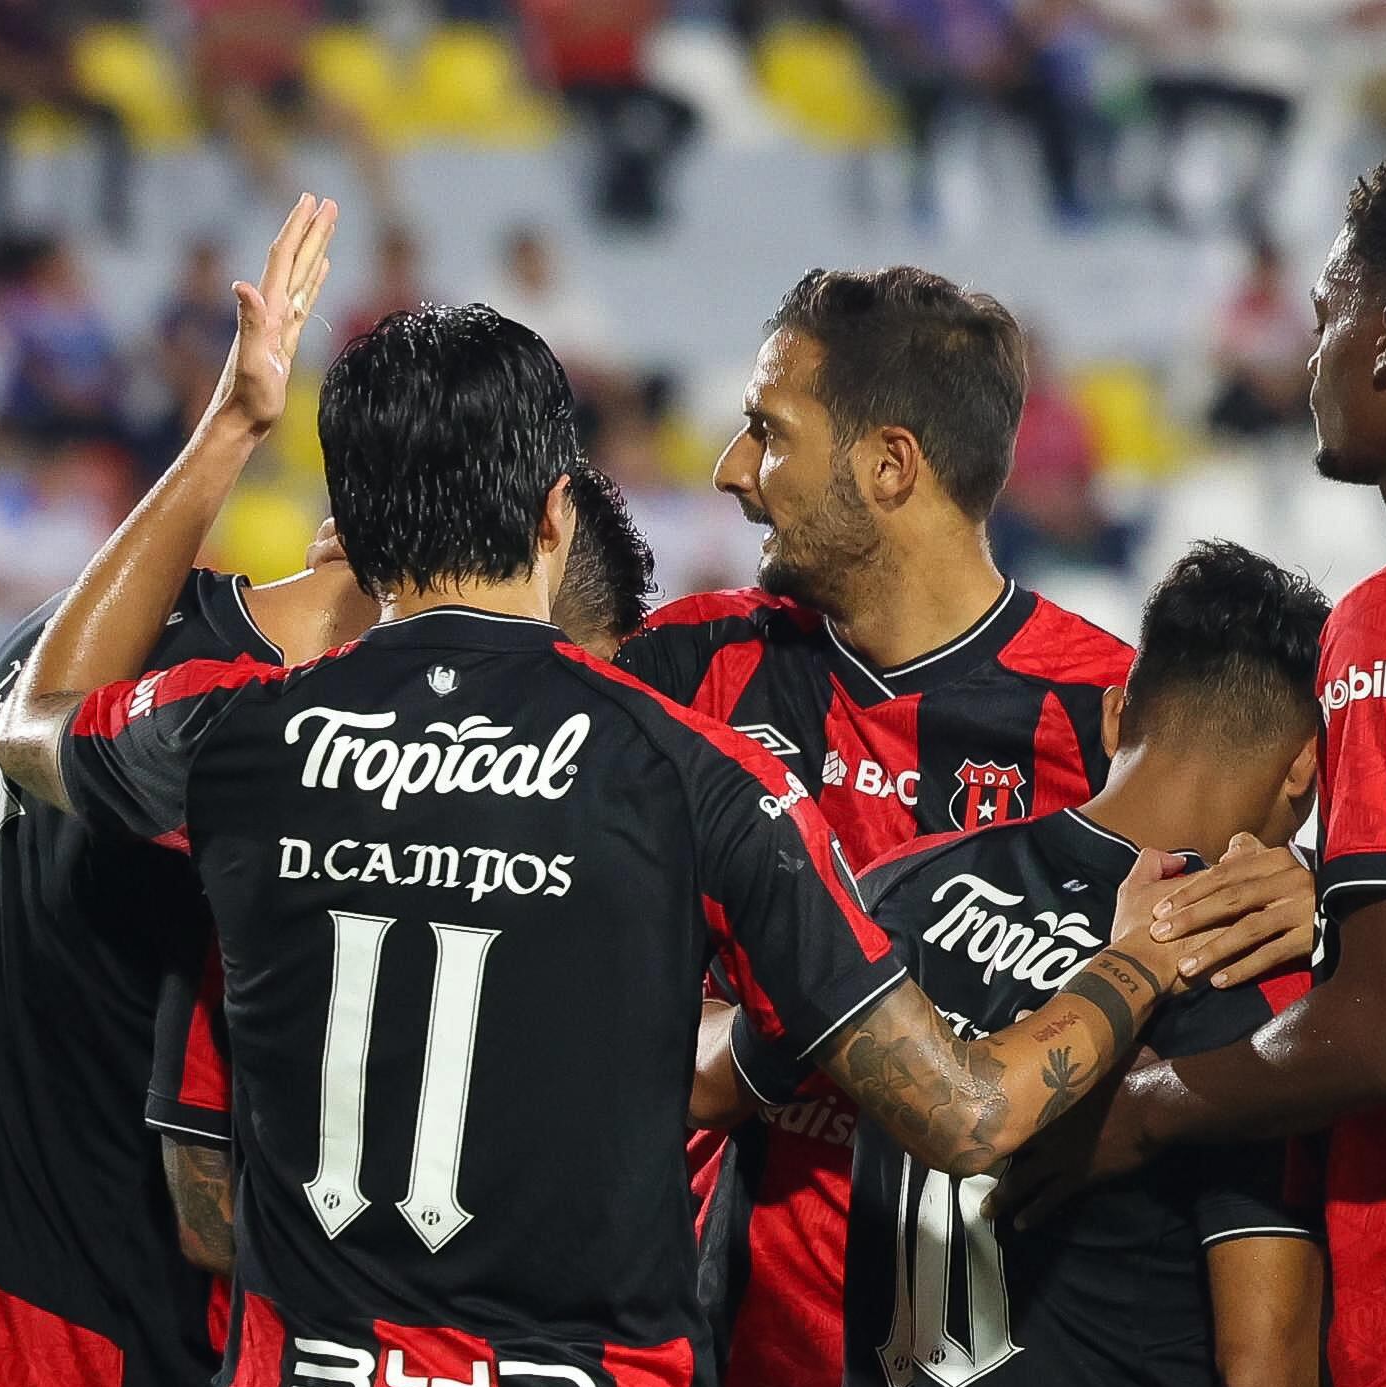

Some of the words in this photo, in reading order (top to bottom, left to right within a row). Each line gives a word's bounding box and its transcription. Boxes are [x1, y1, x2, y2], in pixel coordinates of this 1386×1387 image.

[284, 706, 591, 811] Tropical
[968, 770, 1011, 787] LDA
[278, 836, 576, 903] D.CAMPOS
[922, 873, 1094, 991] Tropic
[302, 910, 503, 1254] 11
